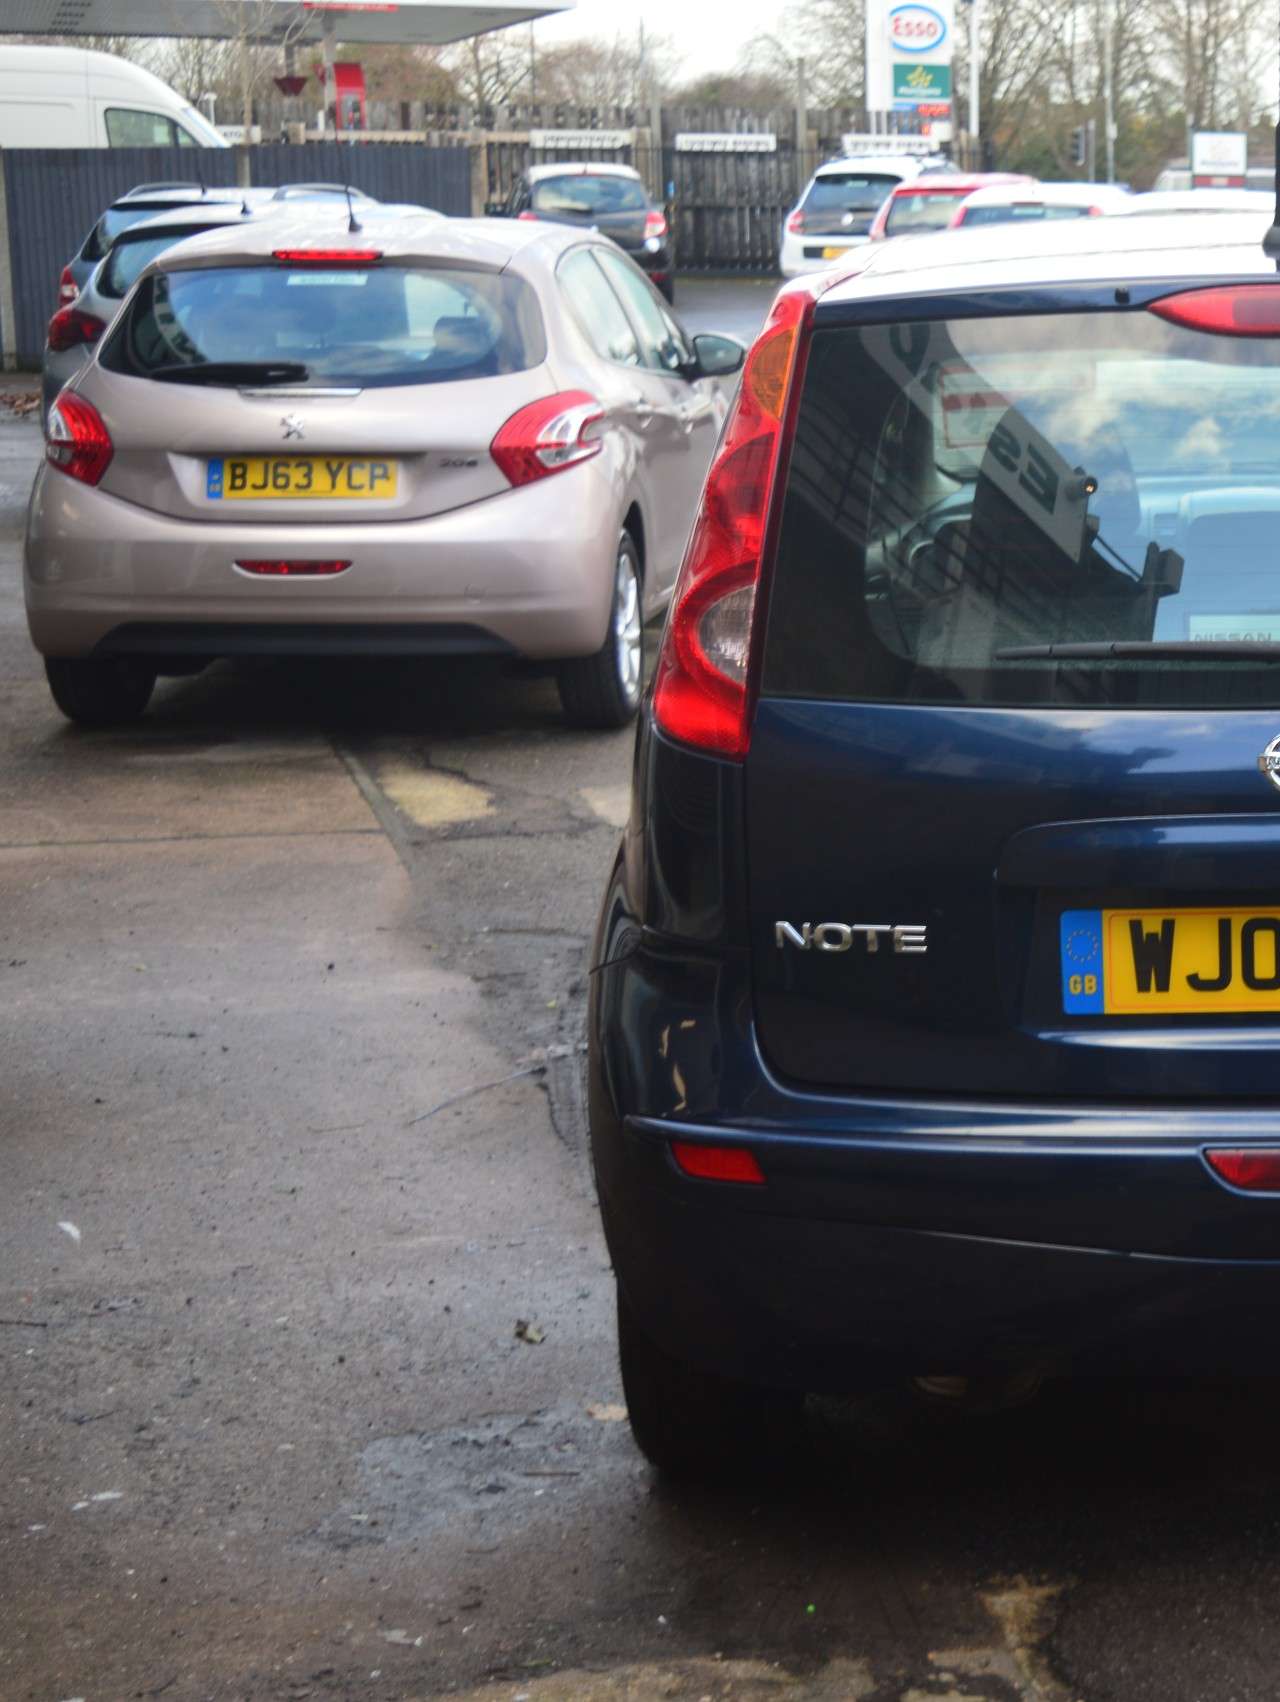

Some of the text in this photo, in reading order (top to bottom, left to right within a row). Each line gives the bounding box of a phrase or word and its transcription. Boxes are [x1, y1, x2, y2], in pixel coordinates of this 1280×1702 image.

[893, 15, 938, 36] Esso
[229, 461, 390, 491] BJ63 YCP
[775, 920, 928, 952] NOTE
[1069, 974, 1096, 996] GB
